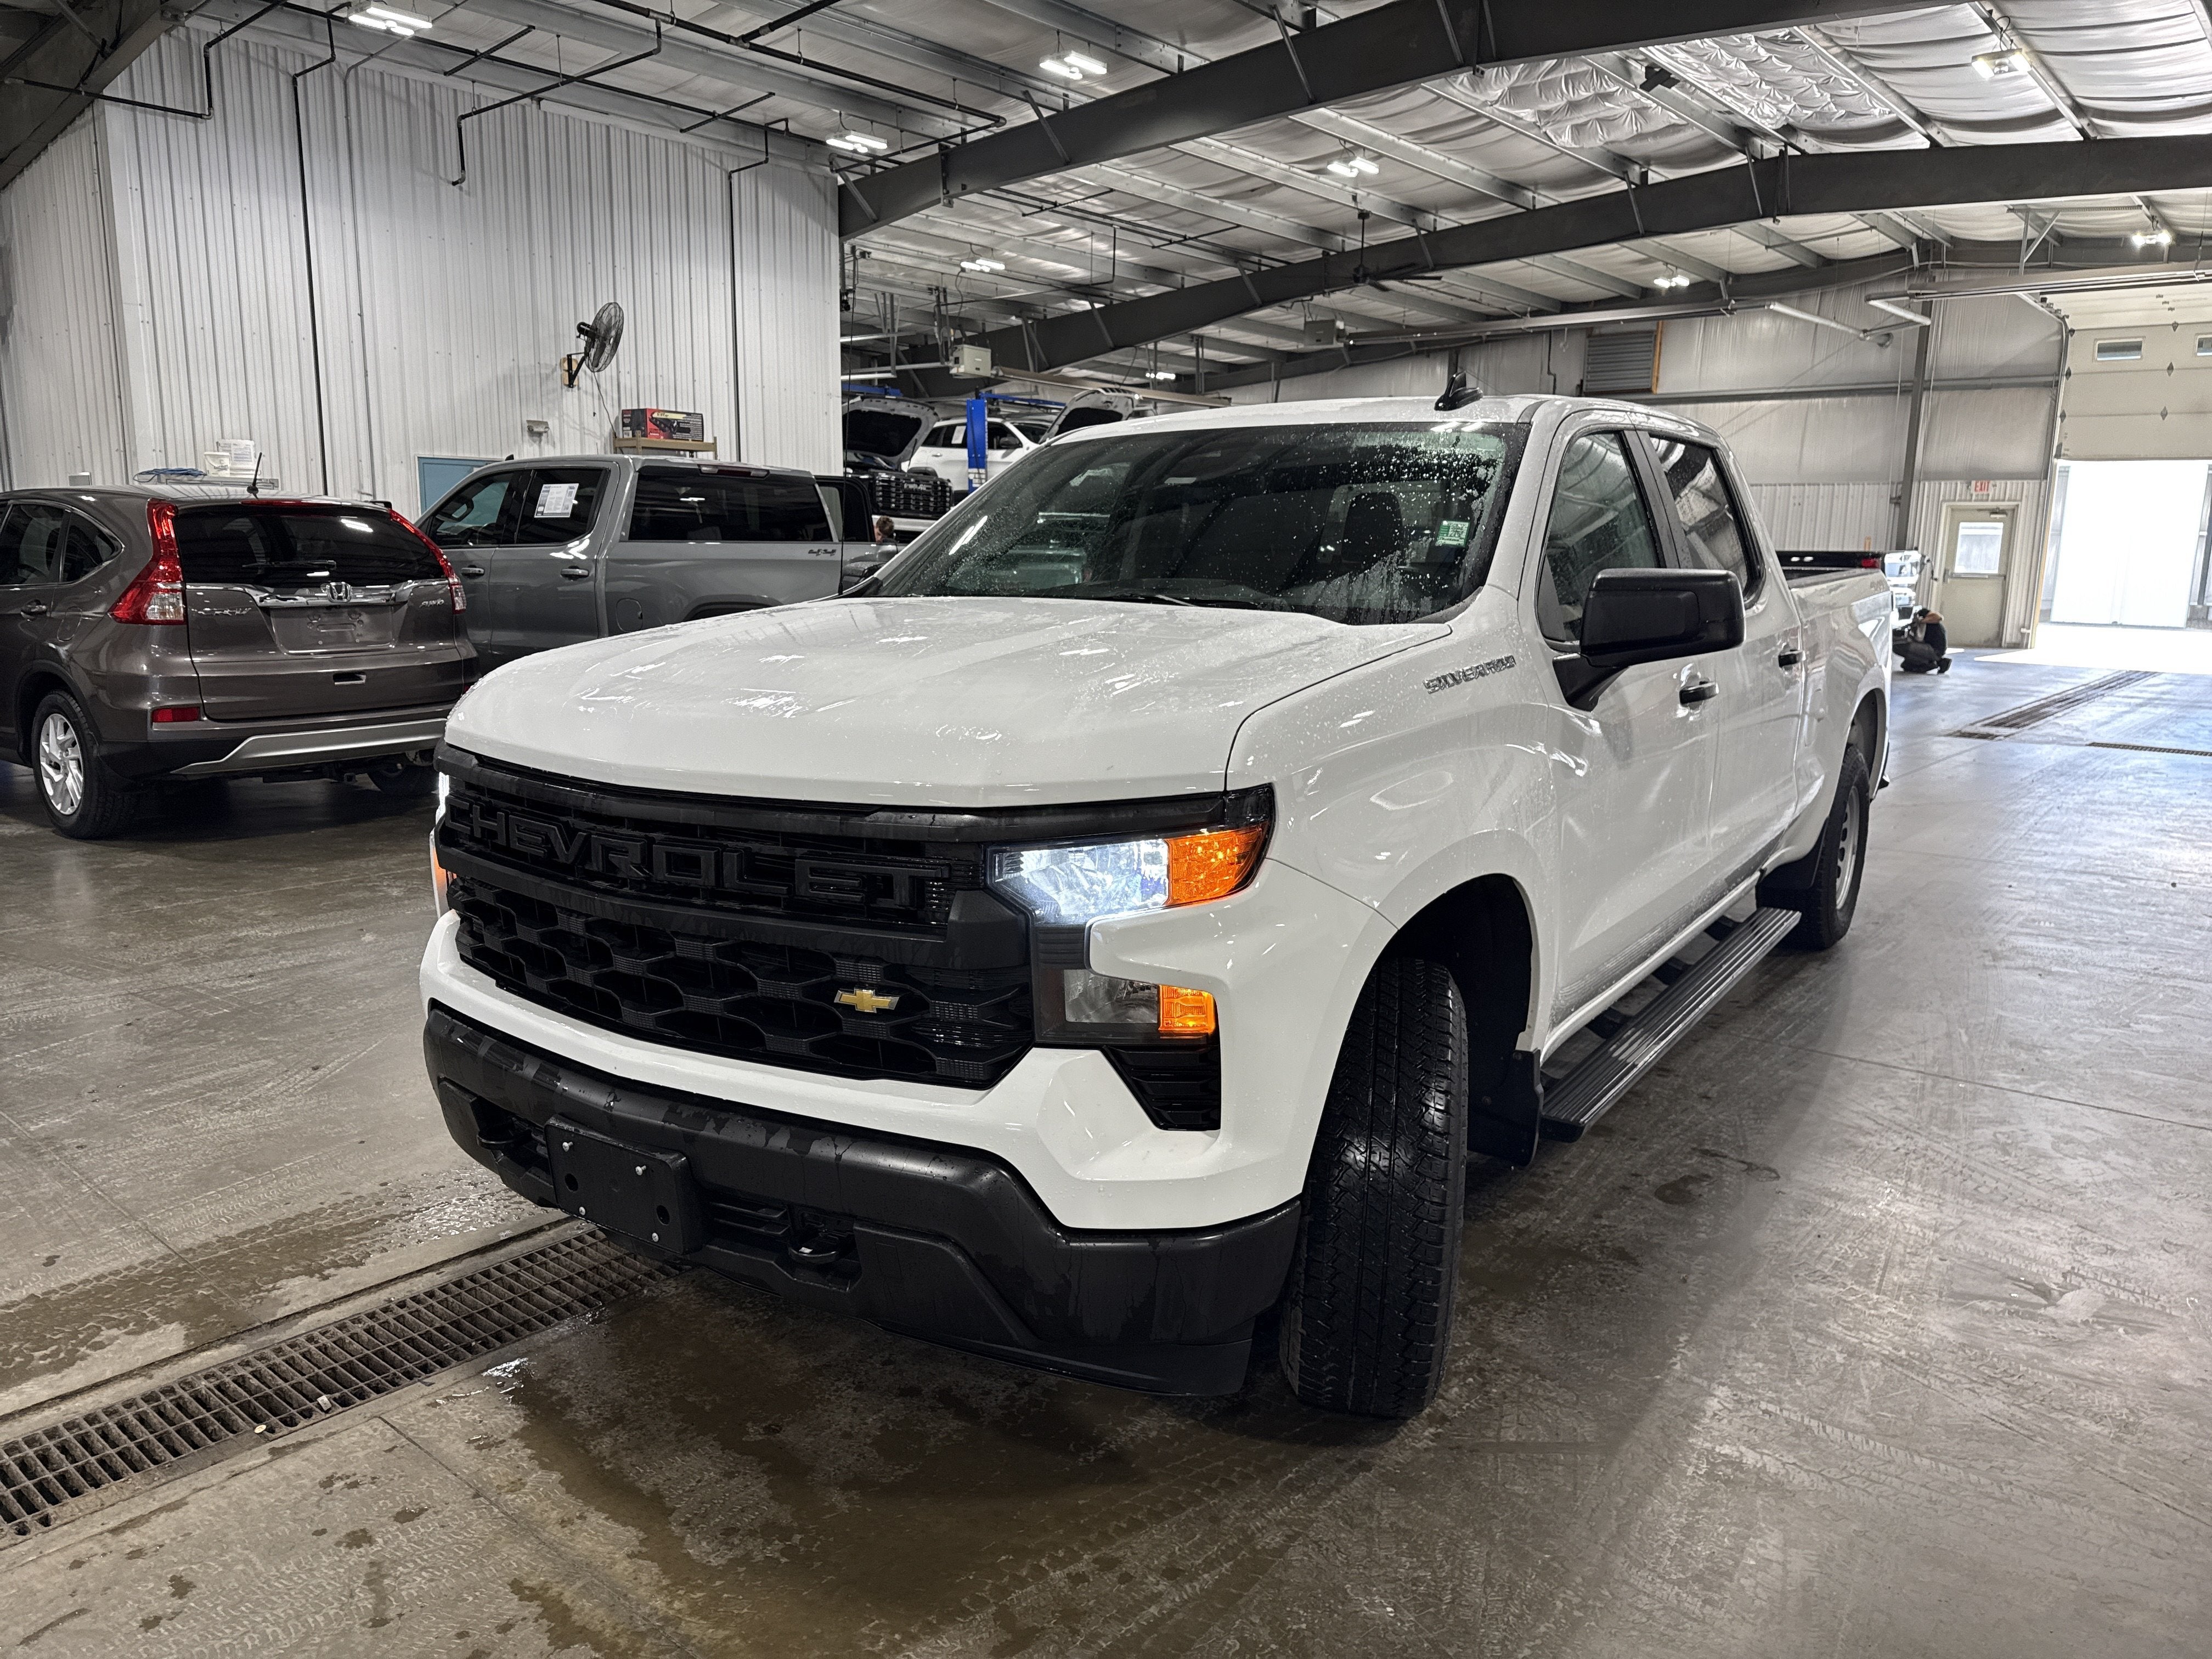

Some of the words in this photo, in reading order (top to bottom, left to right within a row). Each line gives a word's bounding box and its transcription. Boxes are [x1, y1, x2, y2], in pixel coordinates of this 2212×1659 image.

[1974, 480, 1991, 492] EXIT
[419, 599, 445, 608] AWD
[1423, 654, 1517, 695] SILVERADO
[443, 798, 945, 906] CHEVROLET
